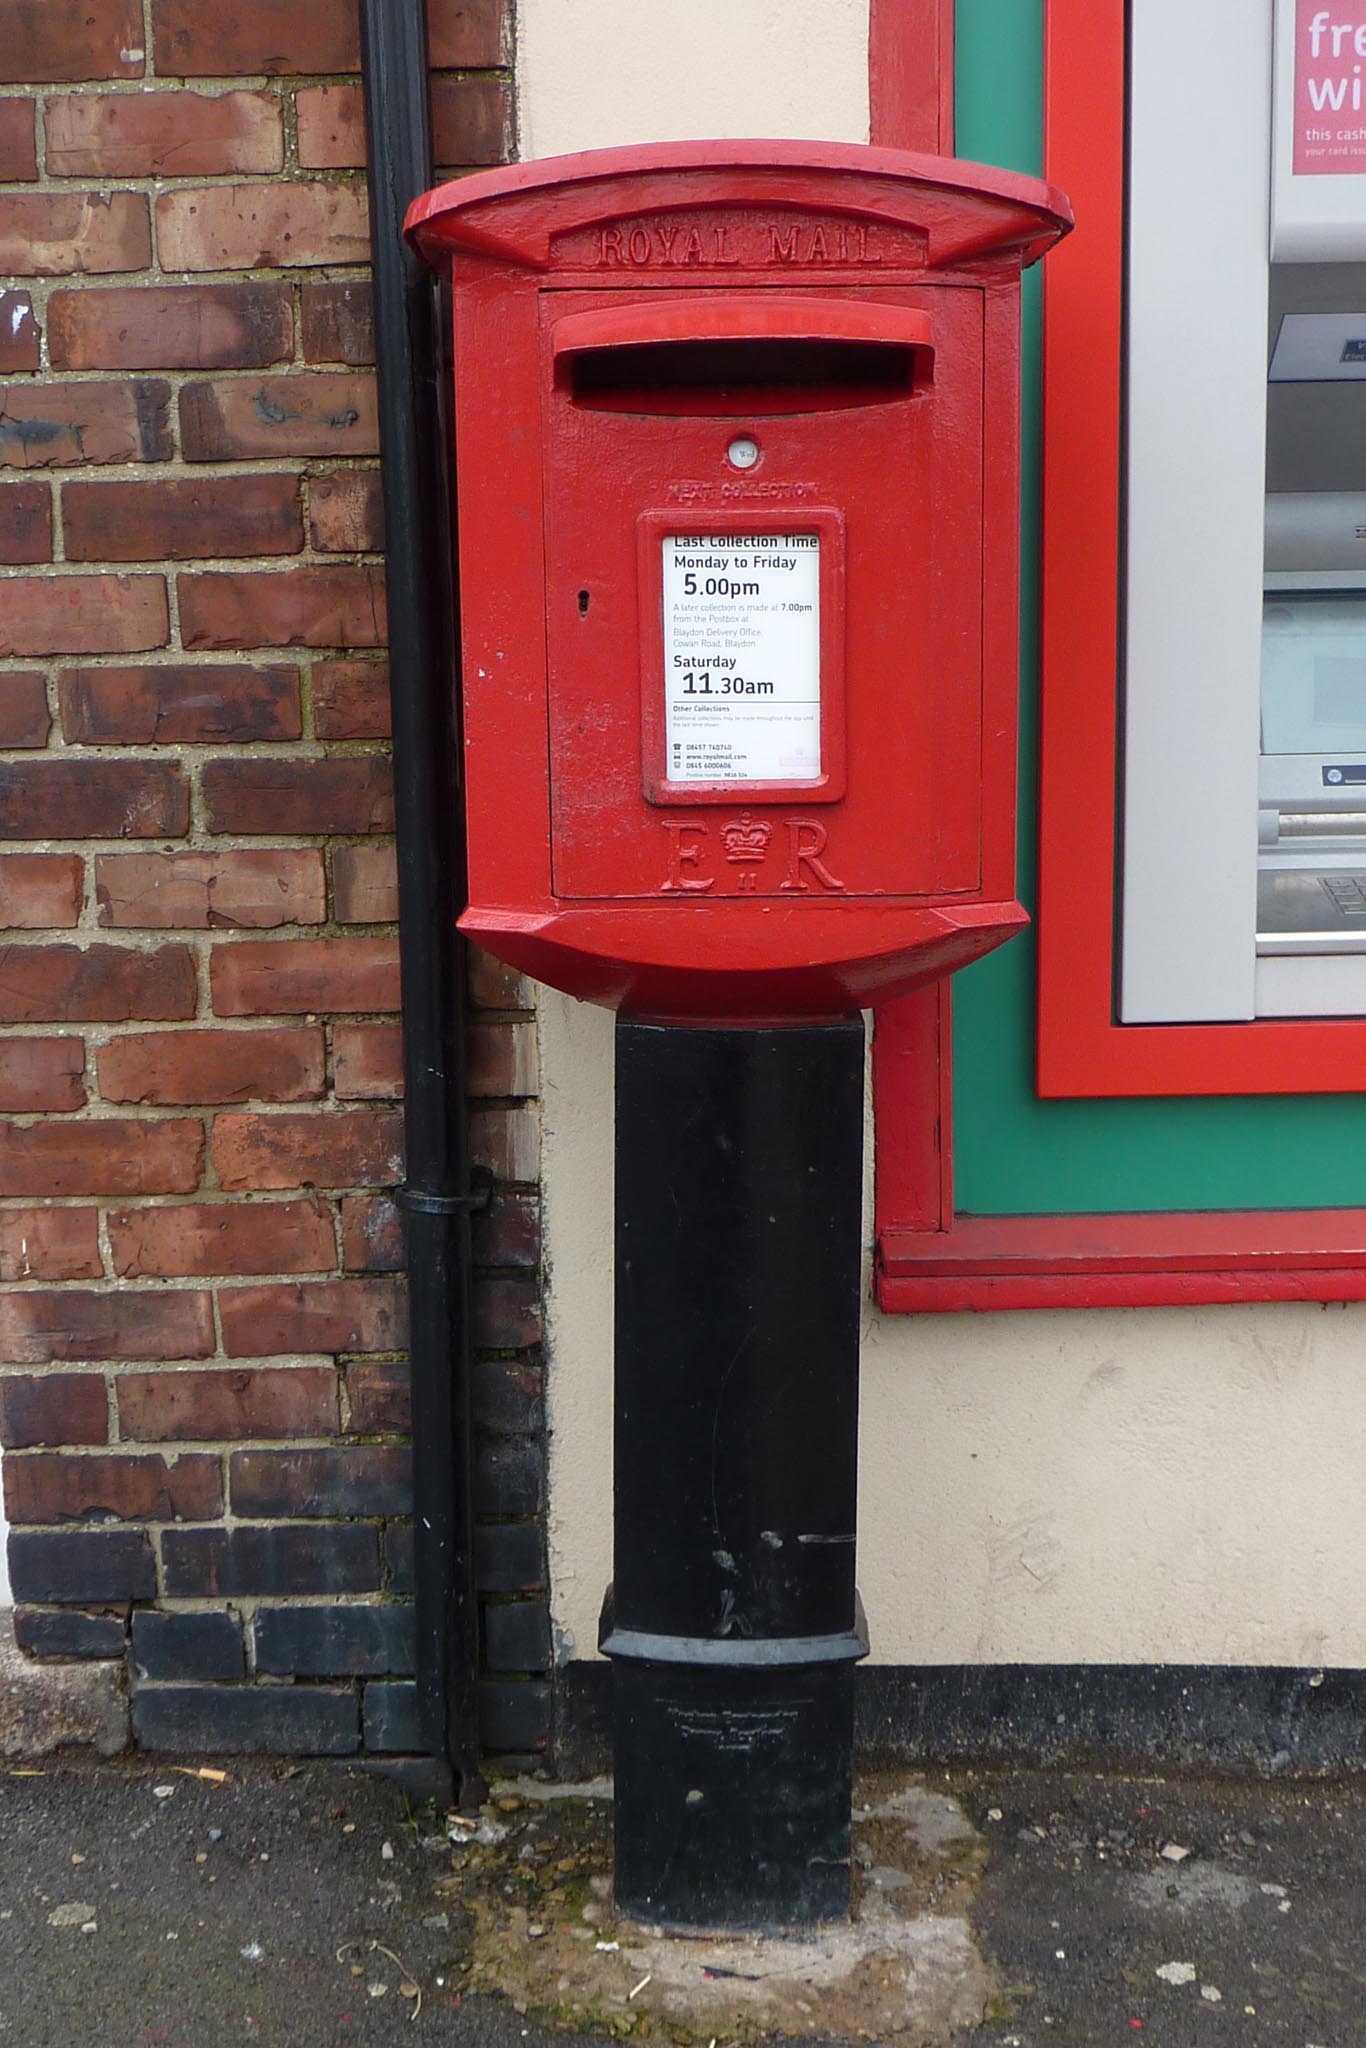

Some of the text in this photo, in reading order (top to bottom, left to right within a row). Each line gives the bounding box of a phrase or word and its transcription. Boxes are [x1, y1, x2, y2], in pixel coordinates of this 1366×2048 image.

[1305, 128, 1332, 141] this
[595, 225, 882, 265] ROYAL MAIL
[674, 534, 818, 548] Last Collection Time
[674, 555, 797, 571] Monday to Friday
[684, 573, 760, 599] 5.00pm
[681, 603, 698, 612] later
[700, 603, 737, 612] collection
[747, 603, 769, 612] made
[781, 602, 813, 613] 7.00pm
[673, 614, 692, 623] from
[694, 614, 707, 623] the
[709, 614, 739, 623] Postbox
[673, 627, 704, 638] Blaydon
[706, 627, 738, 637] Delivery
[673, 639, 699, 648] Cowan
[724, 639, 757, 649] Blaydon
[673, 655, 737, 670] Saturday
[682, 672, 774, 694] 11.30am
[660, 816, 845, 890] E R
